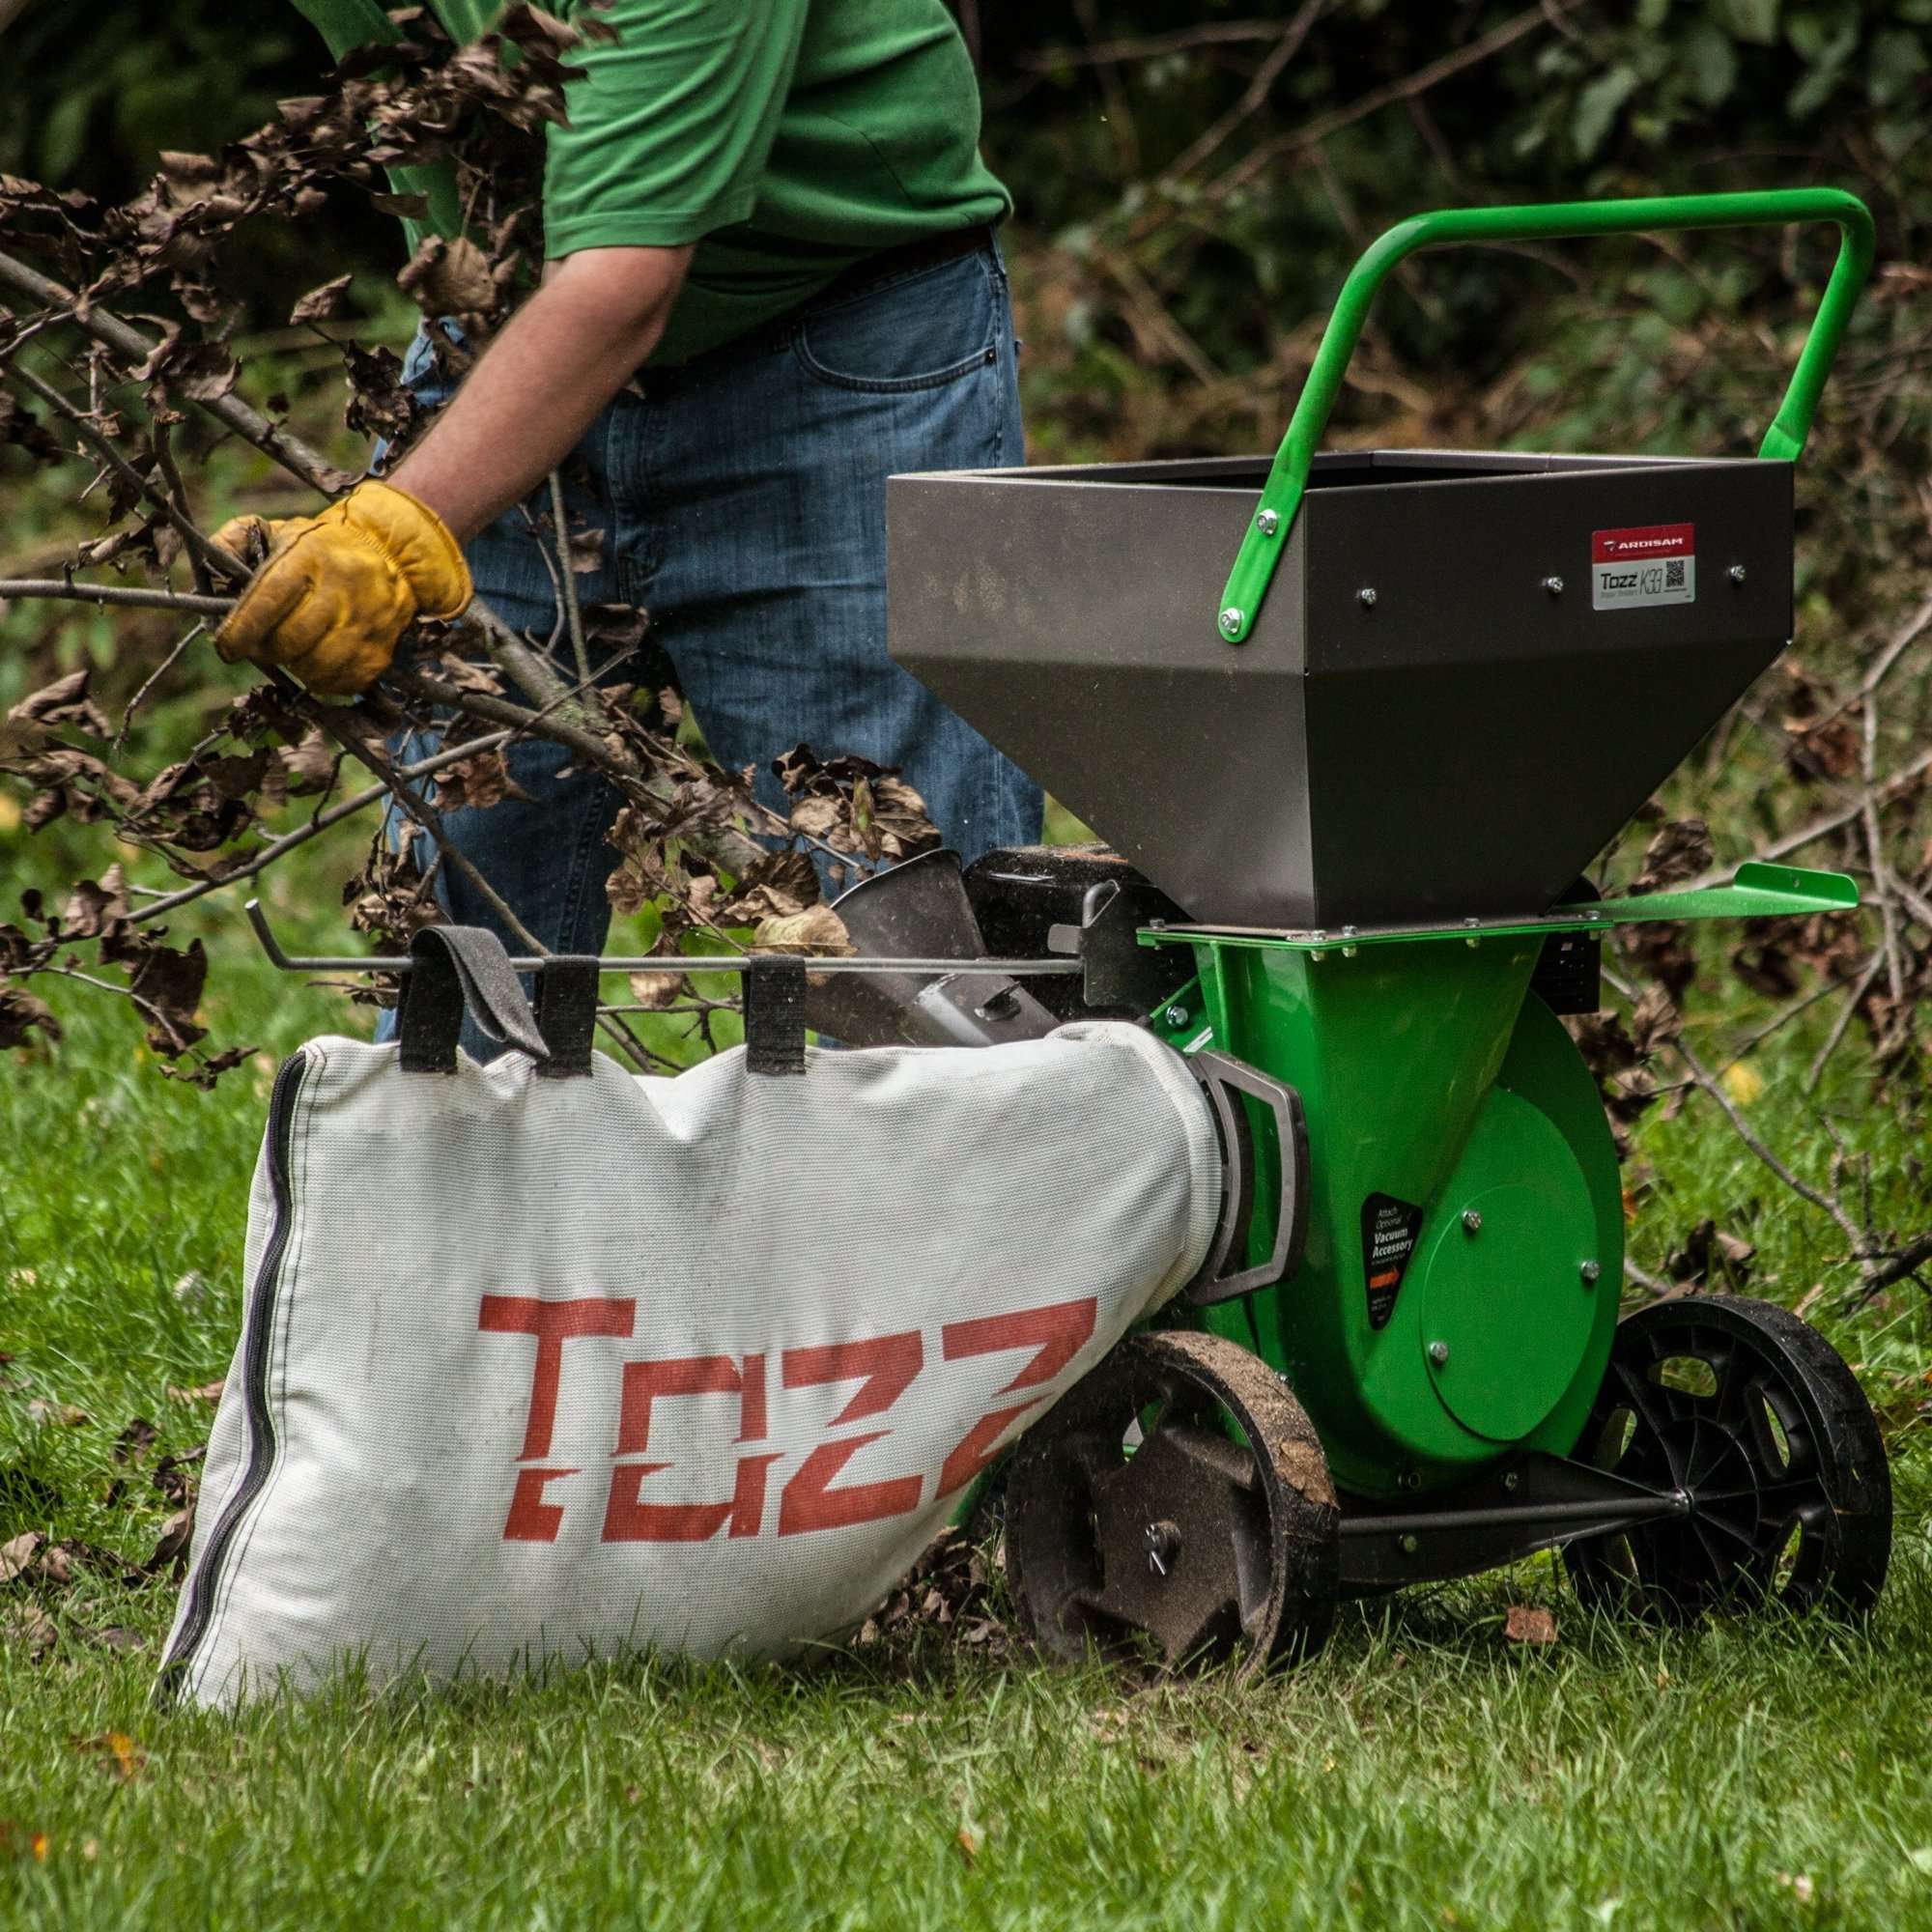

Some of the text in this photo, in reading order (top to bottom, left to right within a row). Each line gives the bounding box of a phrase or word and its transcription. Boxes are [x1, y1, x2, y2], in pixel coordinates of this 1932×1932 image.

[1618, 537, 1684, 550] ARDISAM
[1640, 568, 1663, 595] K33
[1375, 1228, 1408, 1245] Vacuum
[1373, 1238, 1413, 1259] Accessory
[478, 1295, 1097, 1544] Tazz
